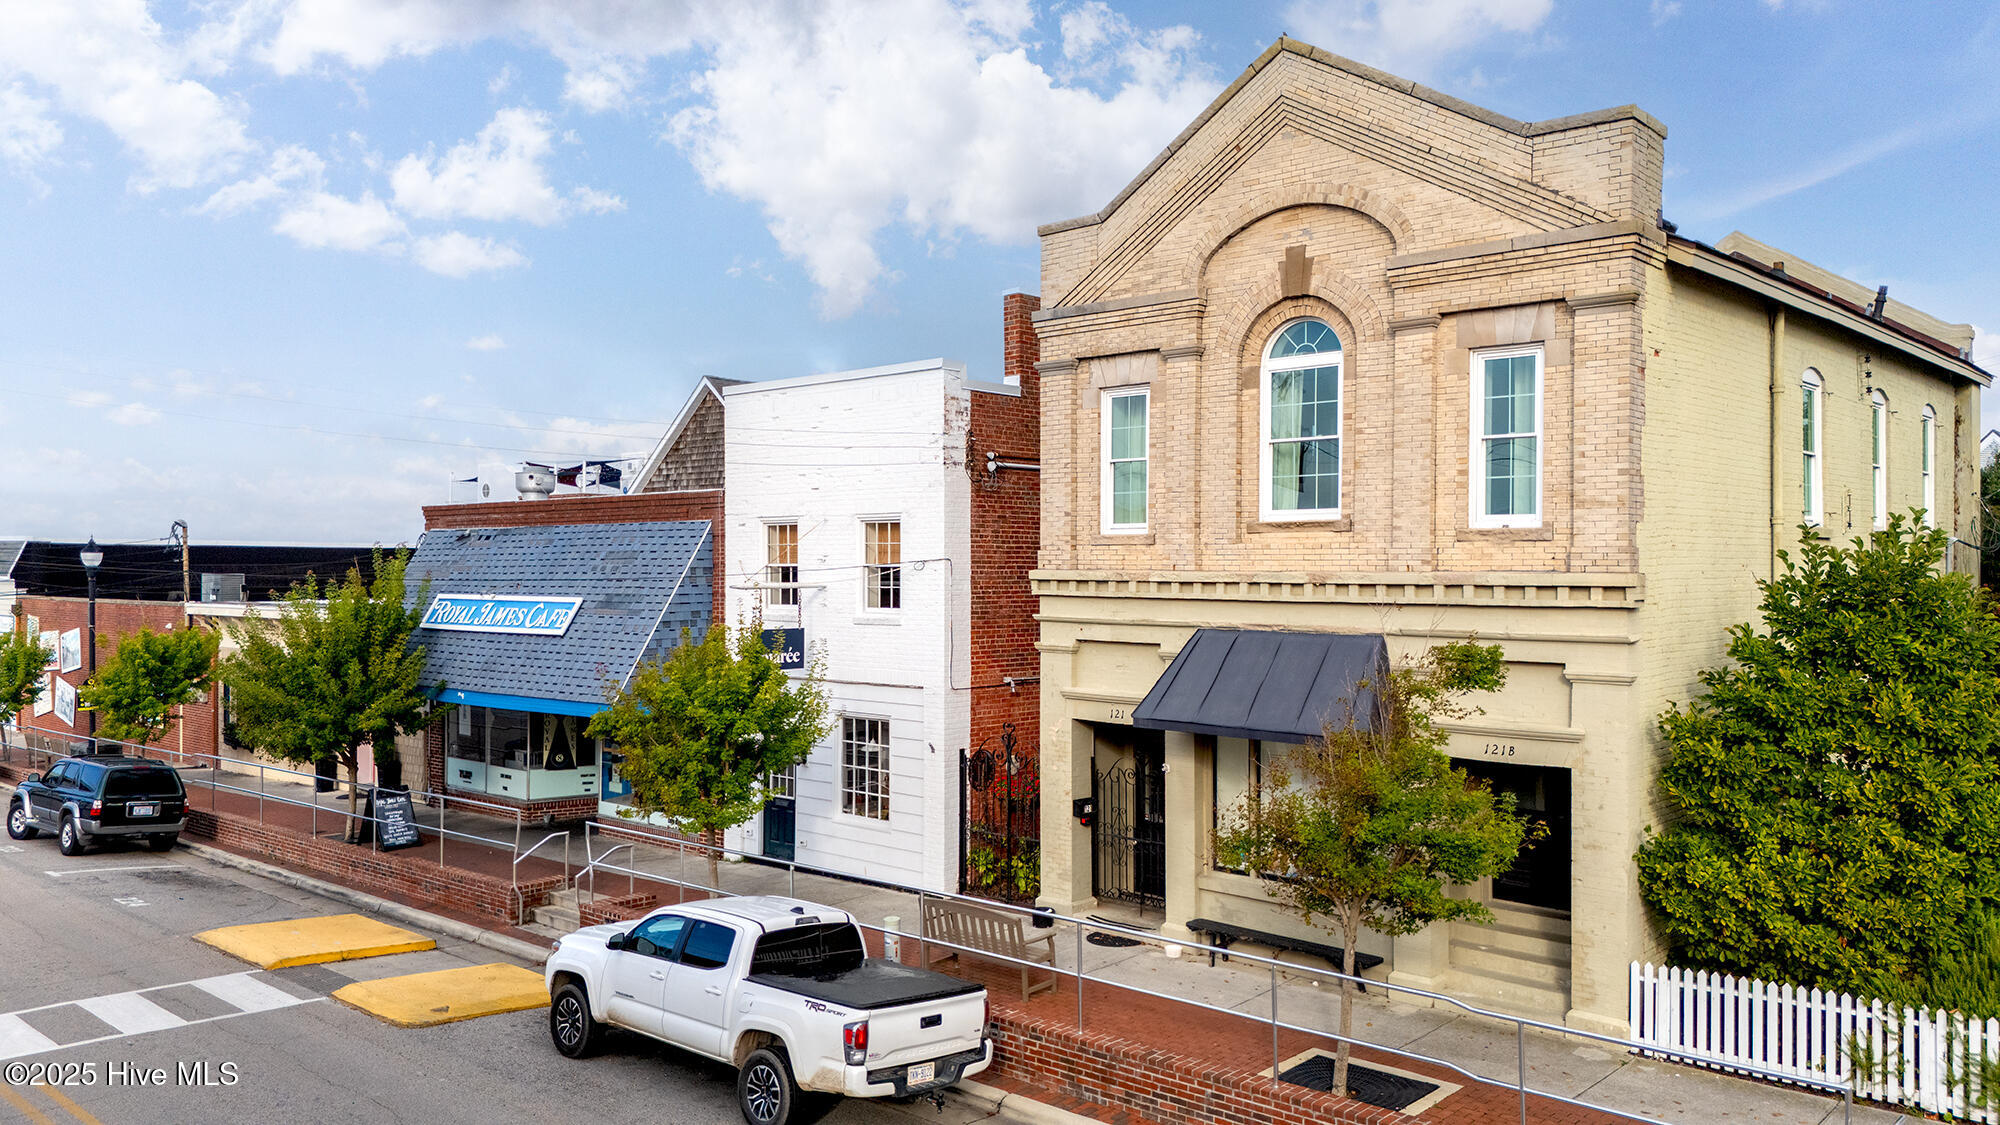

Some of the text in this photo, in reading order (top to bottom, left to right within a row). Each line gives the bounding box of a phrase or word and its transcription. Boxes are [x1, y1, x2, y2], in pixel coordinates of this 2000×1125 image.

[430, 601, 571, 628] ROYAL JAMES CAFE
[1110, 709, 1124, 719] 121
[1484, 743, 1515, 757] 121B
[804, 999, 847, 1017] TRD SPORT
